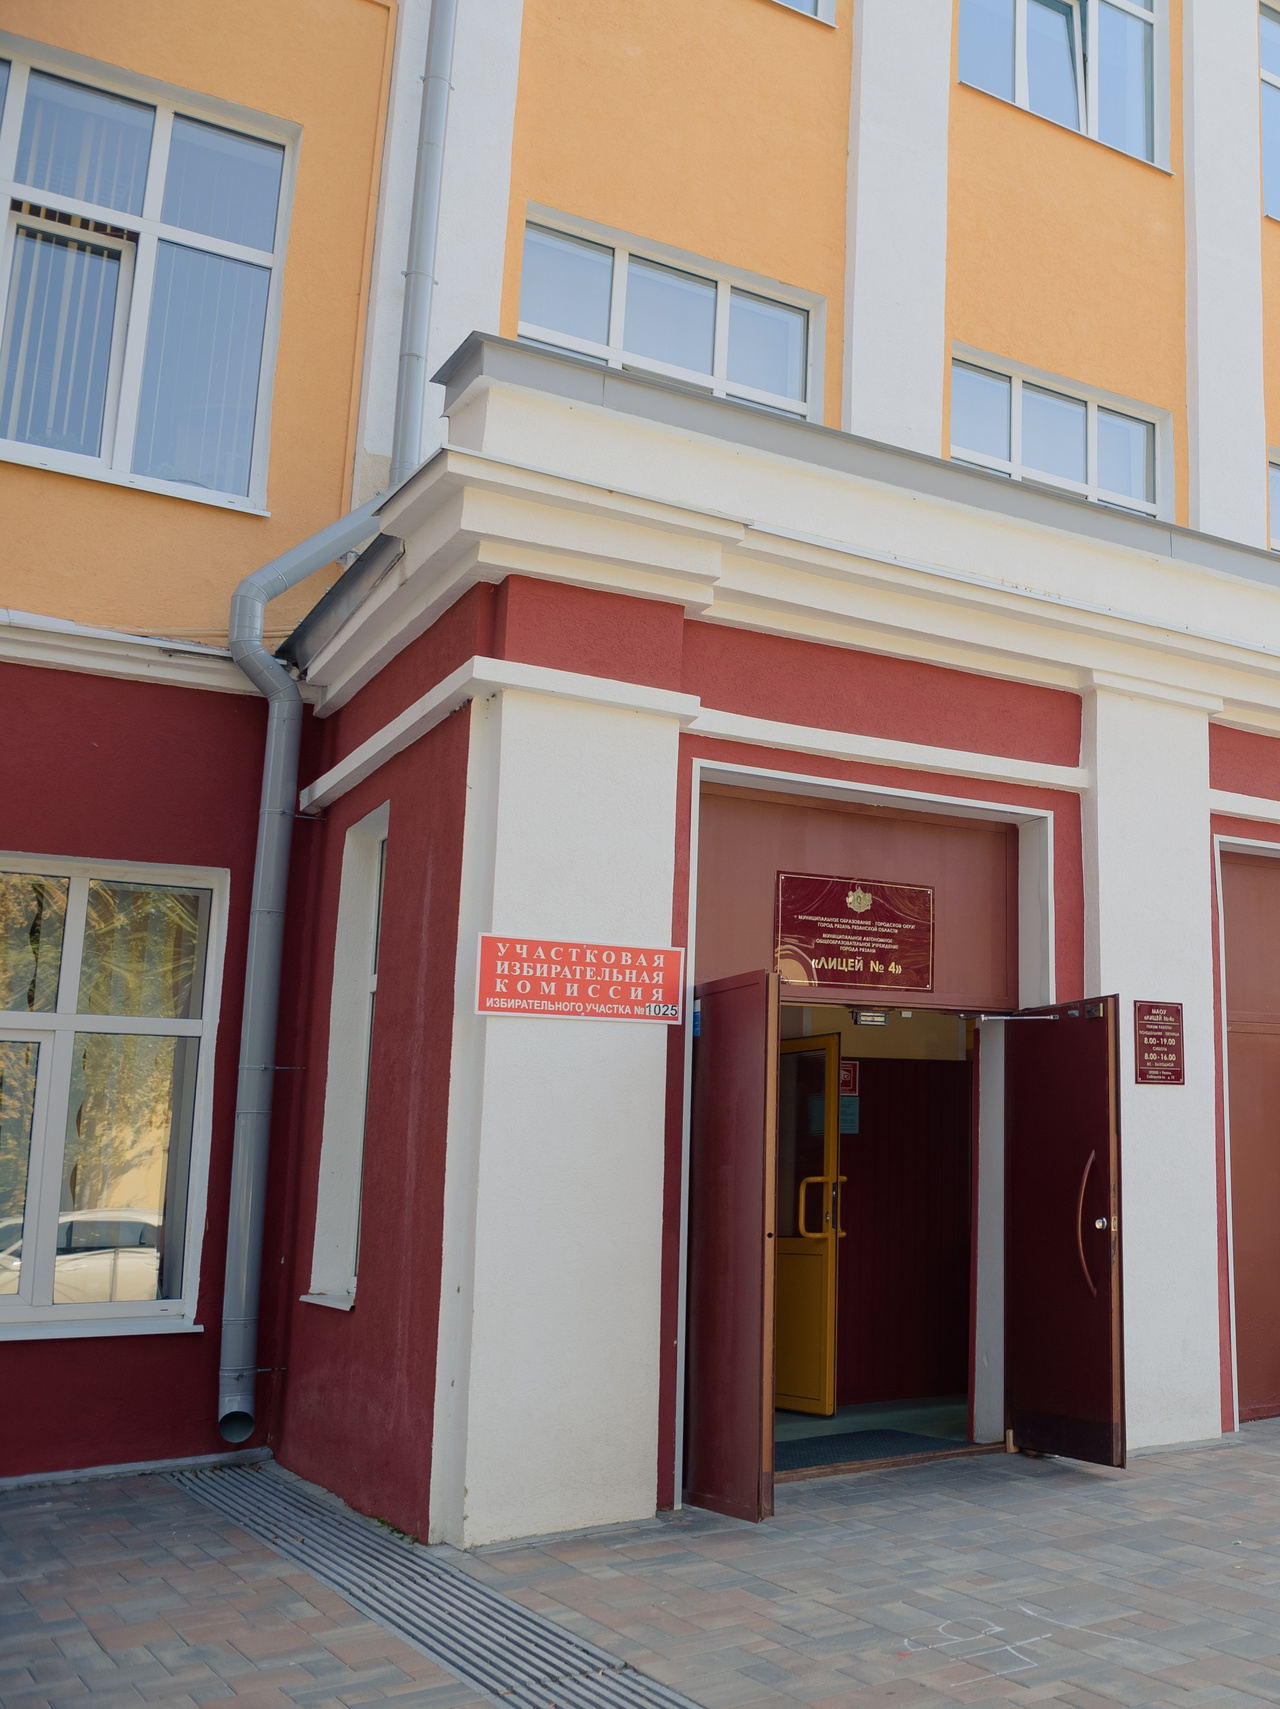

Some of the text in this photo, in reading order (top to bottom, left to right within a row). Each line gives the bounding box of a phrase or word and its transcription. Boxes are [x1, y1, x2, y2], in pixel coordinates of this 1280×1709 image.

[496, 942, 665, 968] УЧАСТКОВАЯ
[811, 955, 864, 973] «ЛИЦЕЙ
[495, 960, 664, 985] ИЗБИРАТЕЛЬНАЯ
[494, 978, 664, 1002] КОМИССИЯ
[486, 997, 584, 1013] ИЗБИРАТЕЛЬНОГО
[585, 1003, 631, 1015] УЧАСТКА
